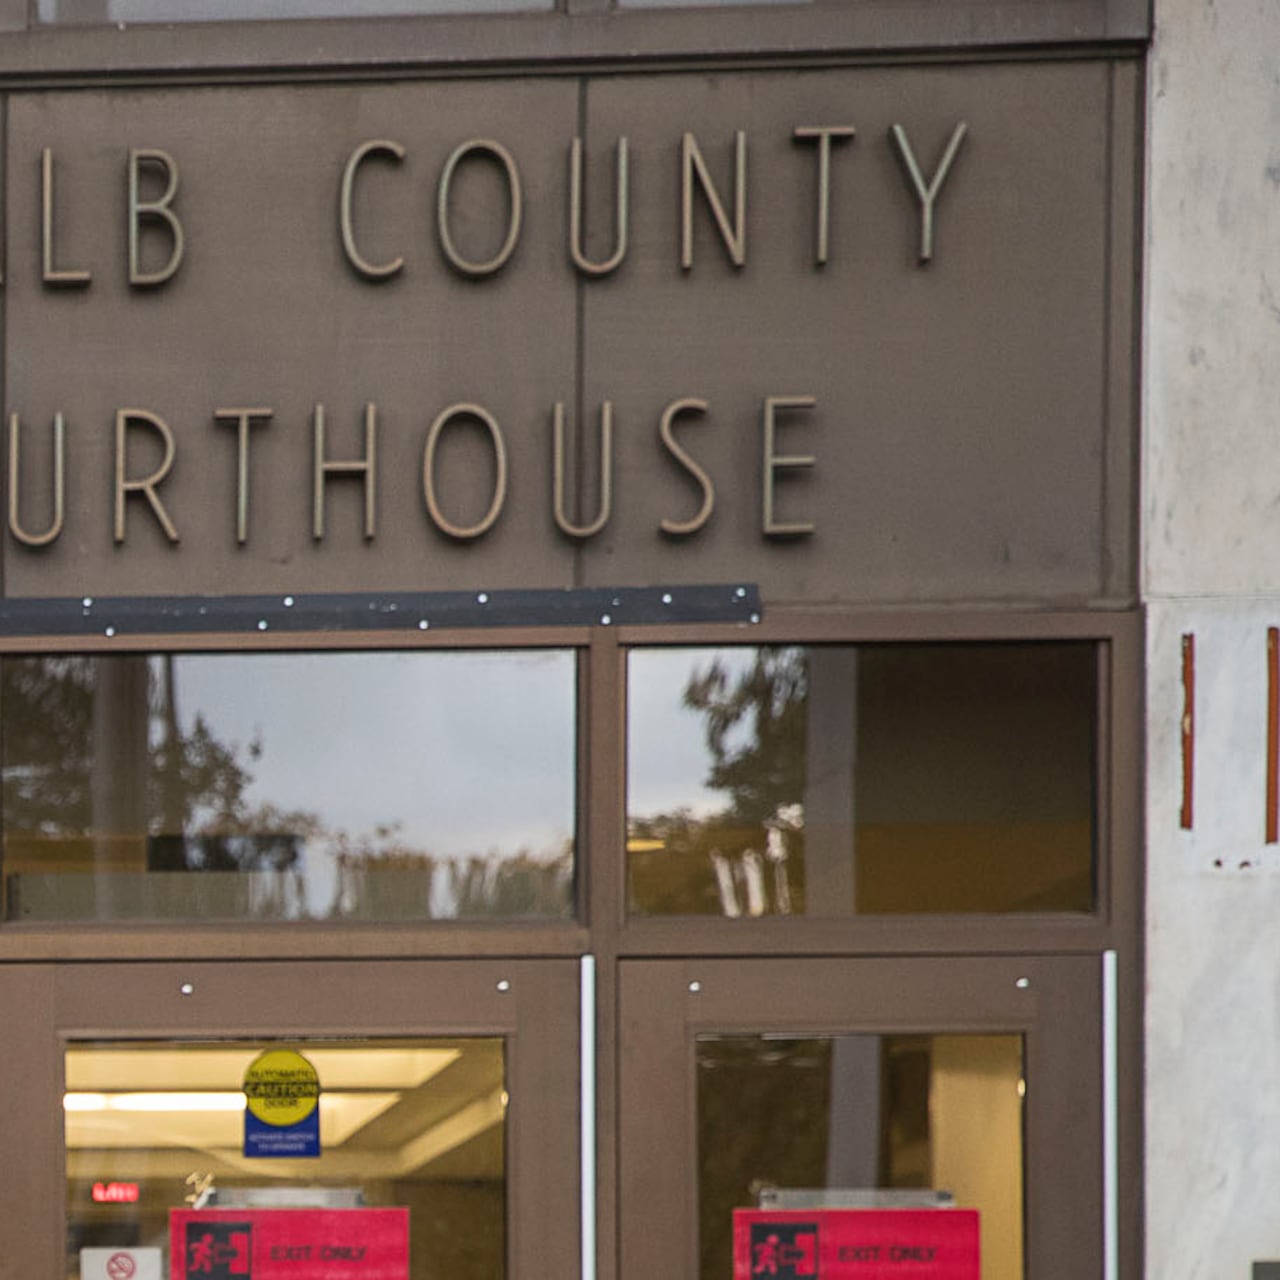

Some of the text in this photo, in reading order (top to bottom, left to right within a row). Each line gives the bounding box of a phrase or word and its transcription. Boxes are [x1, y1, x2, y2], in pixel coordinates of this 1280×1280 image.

[340, 121, 968, 277] COUNTY
[270, 1245, 367, 1261] EXIT ONLY
[838, 1246, 938, 1262] EXIT ONLY
